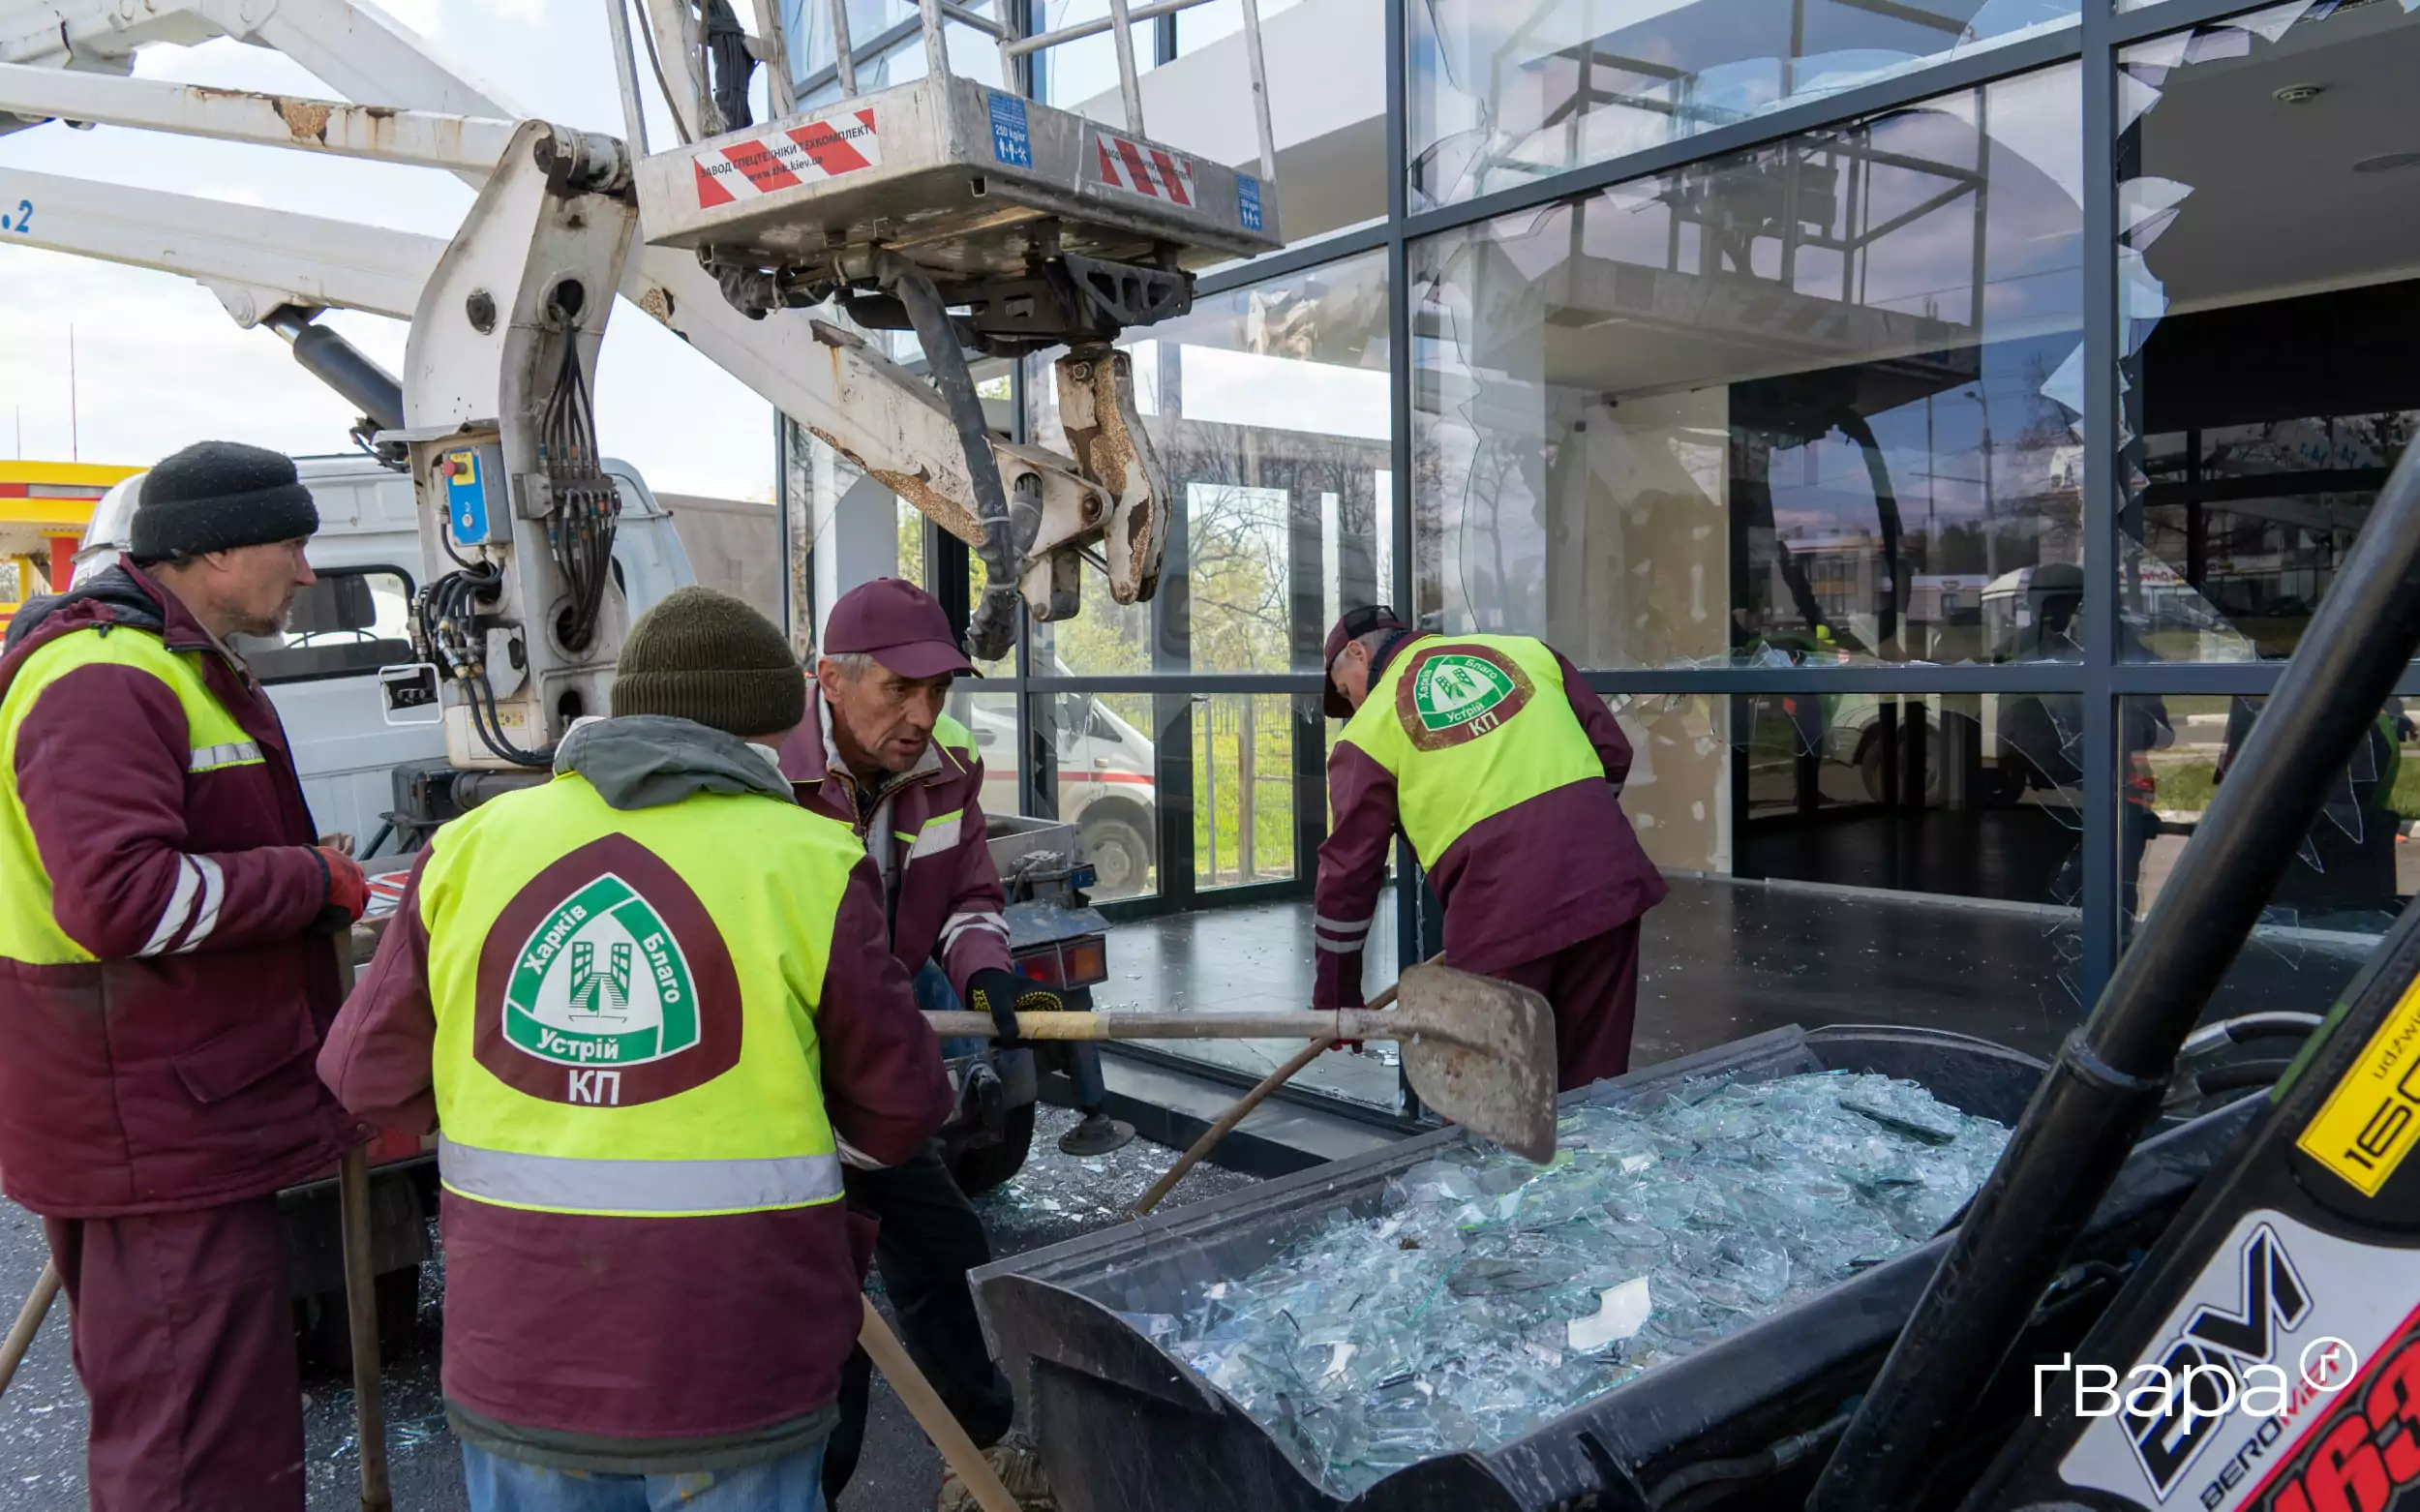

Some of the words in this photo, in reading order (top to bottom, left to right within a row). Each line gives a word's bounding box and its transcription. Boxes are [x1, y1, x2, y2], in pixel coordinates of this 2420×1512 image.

[701, 161, 733, 179] ЗАВОД
[733, 144, 798, 169] СПЕЦТЕХНІКИ
[800, 124, 870, 152] ТЕХКОМПЛЕКТ
[1465, 658, 1497, 680] Благо
[1446, 702, 1485, 722] Устрій
[1468, 711, 1499, 737] КП
[523, 904, 588, 975] Харків
[643, 932, 681, 1003] Благо
[536, 1028, 620, 1061] Устрій
[2373, 1009, 2420, 1079] udźwi
[568, 1070, 621, 1104] КП
